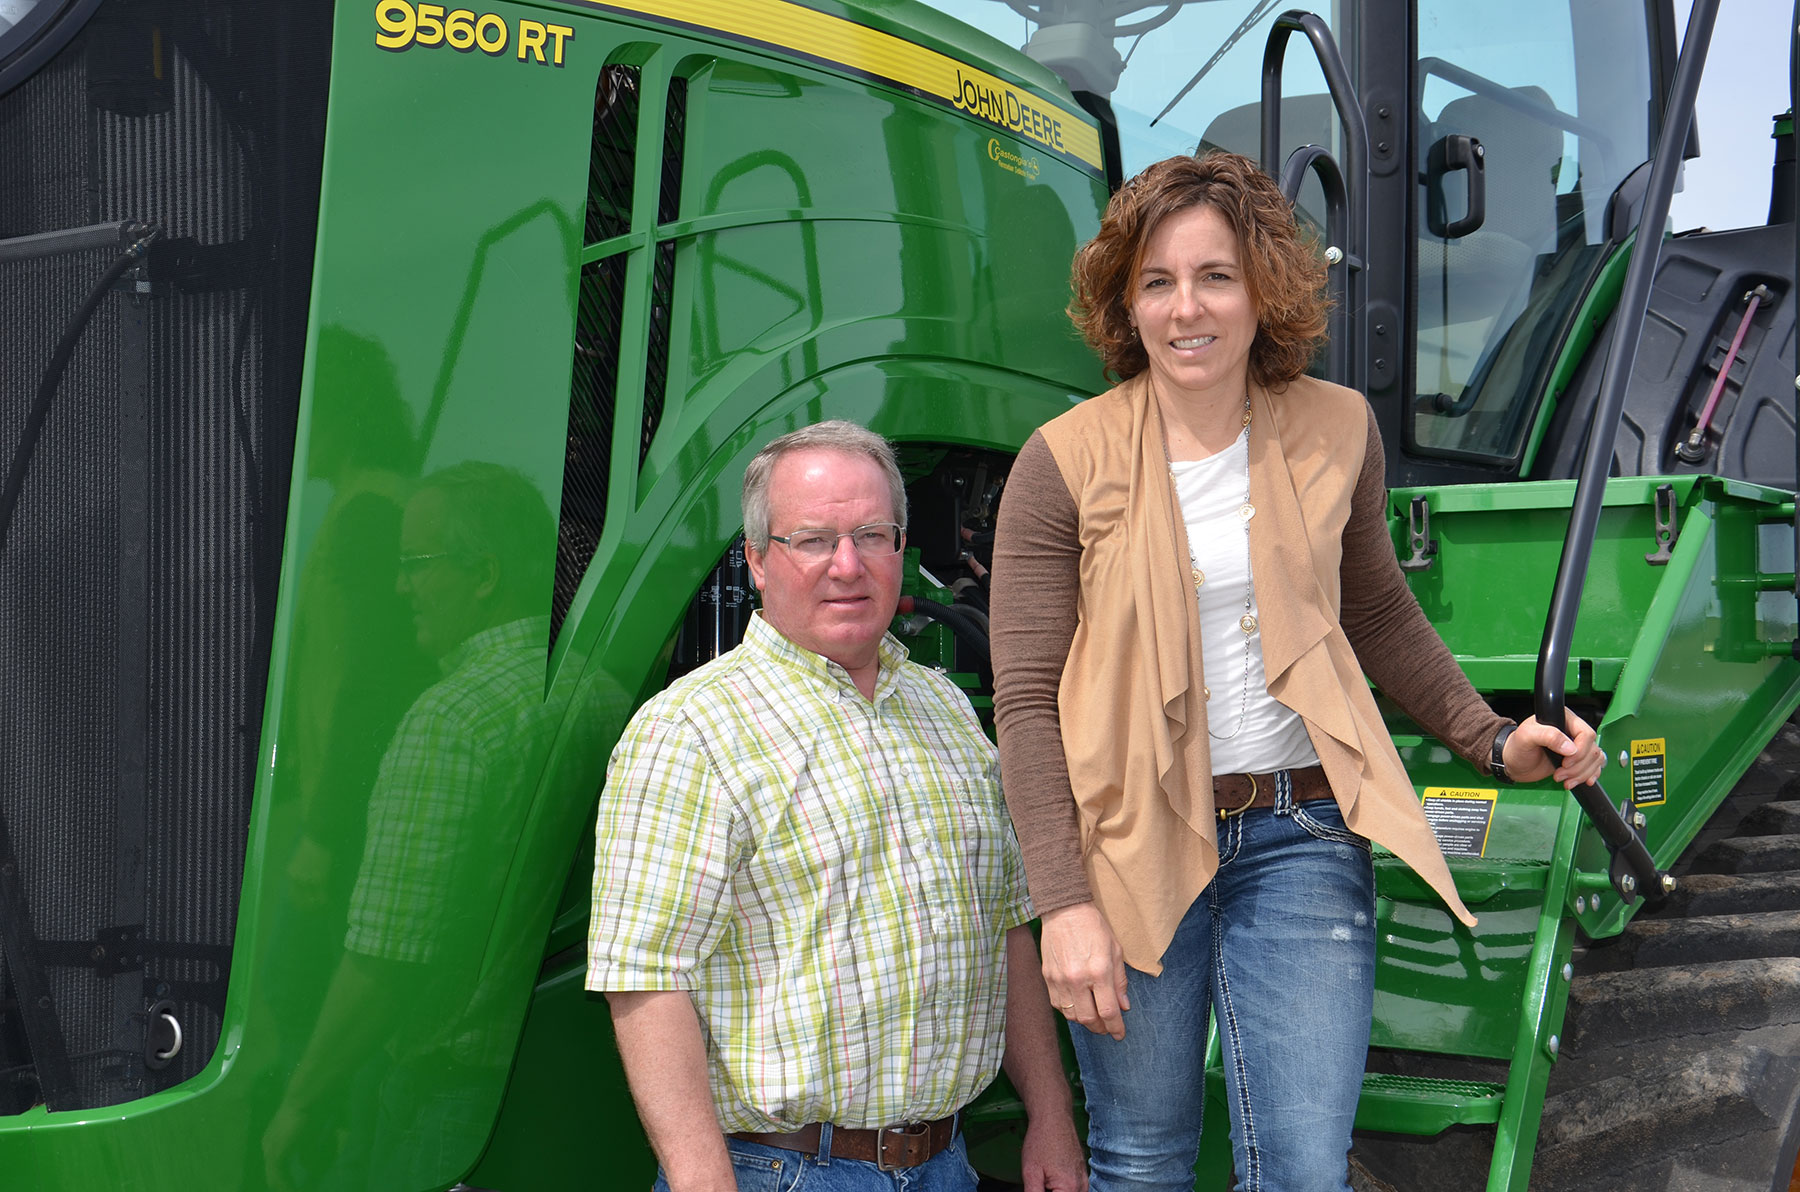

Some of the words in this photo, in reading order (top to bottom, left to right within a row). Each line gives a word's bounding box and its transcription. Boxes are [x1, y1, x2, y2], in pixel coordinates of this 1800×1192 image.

[375, 0, 509, 56] 9560
[517, 19, 574, 67] RT
[952, 69, 1005, 124] JOHN
[1005, 89, 1065, 152] DEERE
[1641, 743, 1661, 754] CAUTION
[1449, 790, 1480, 798] CAUTION
